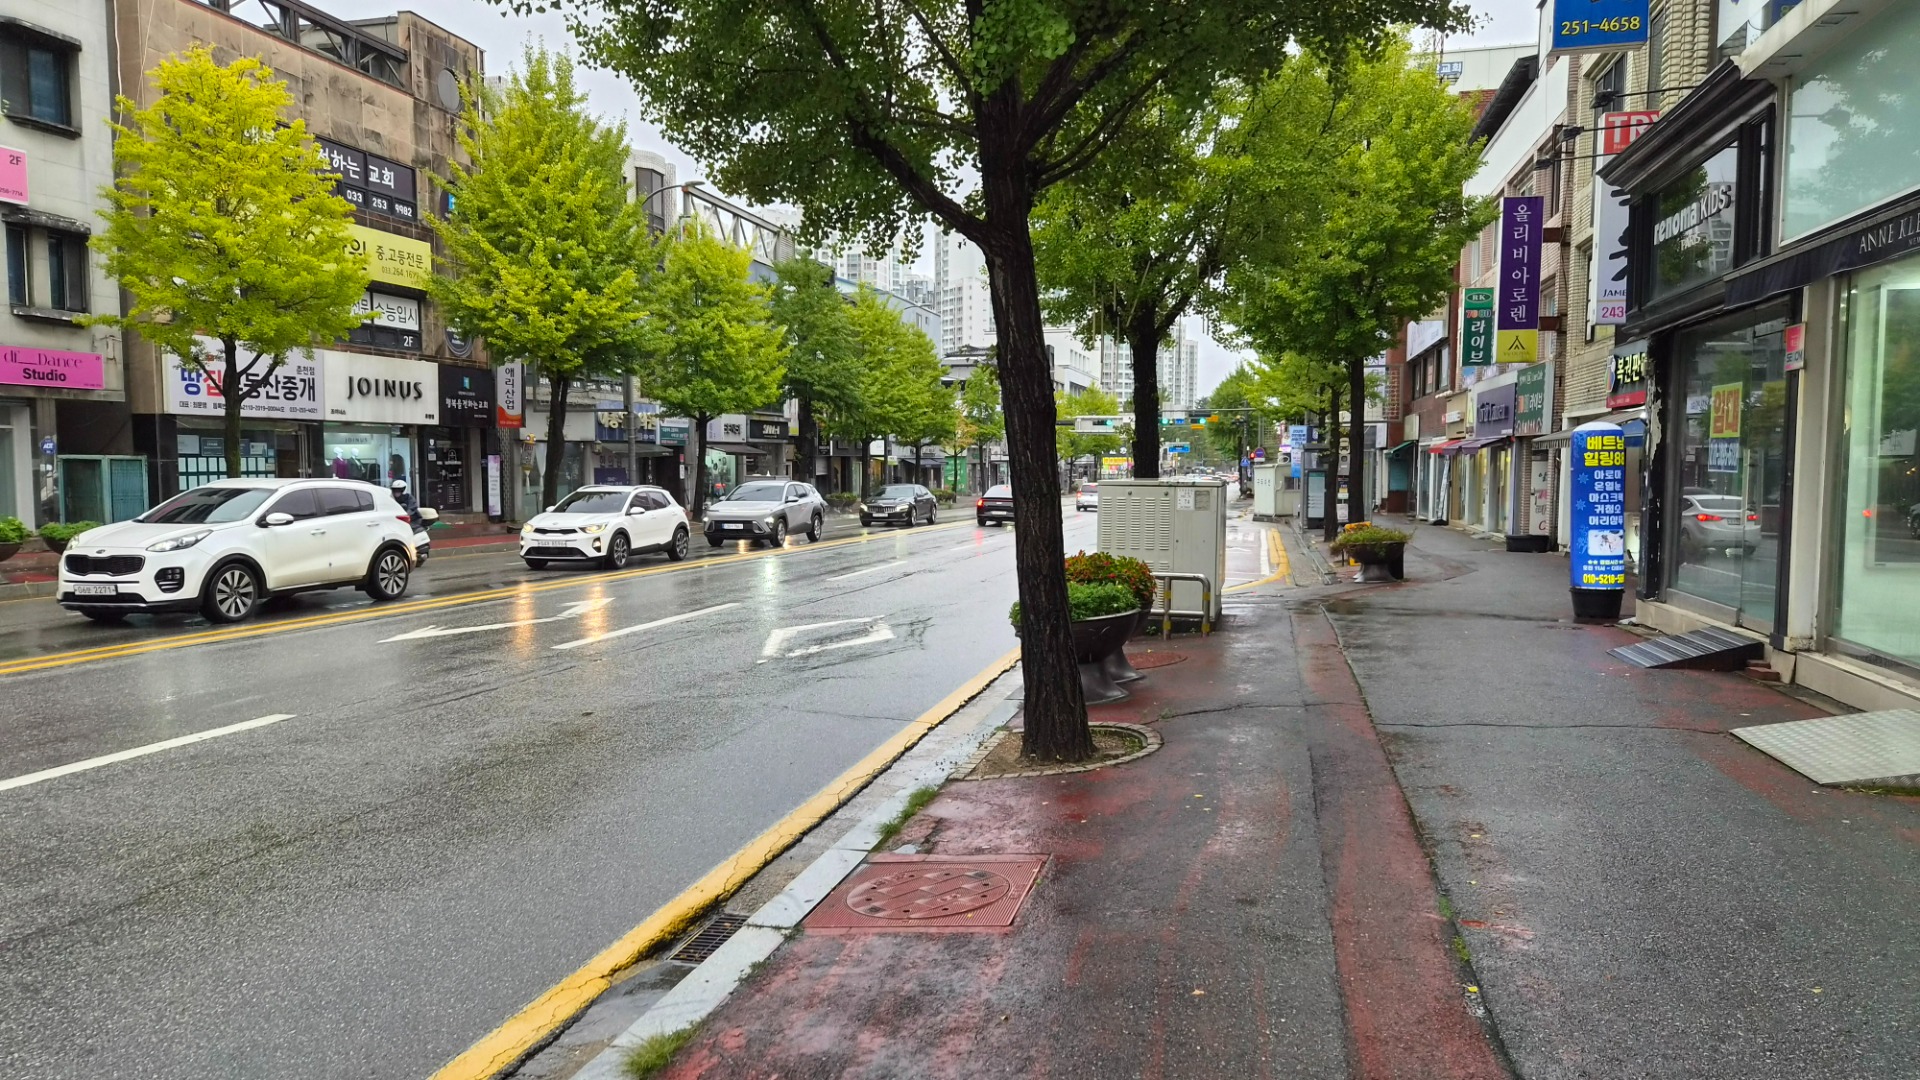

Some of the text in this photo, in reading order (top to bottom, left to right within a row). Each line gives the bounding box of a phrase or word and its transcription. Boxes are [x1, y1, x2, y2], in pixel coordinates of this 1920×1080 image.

[1561, 16, 1640, 35] 251-4658
[9, 155, 22, 165] 2F
[369, 167, 394, 189] 교회
[346, 190, 412, 217] 033 253 9982
[1653, 202, 1700, 246] renoma
[1700, 185, 1731, 220] KIDS
[1859, 224, 1894, 254] ANNE
[1510, 204, 1532, 323] 올리비아로렌
[375, 302, 418, 325] 수능입시
[1602, 306, 1624, 318] 243
[403, 336, 414, 347] 2F
[1469, 320, 1486, 362] 라이브
[23, 368, 67, 381] Studio
[180, 368, 316, 402] 땅집동산중개
[347, 376, 423, 401] JOINUS
